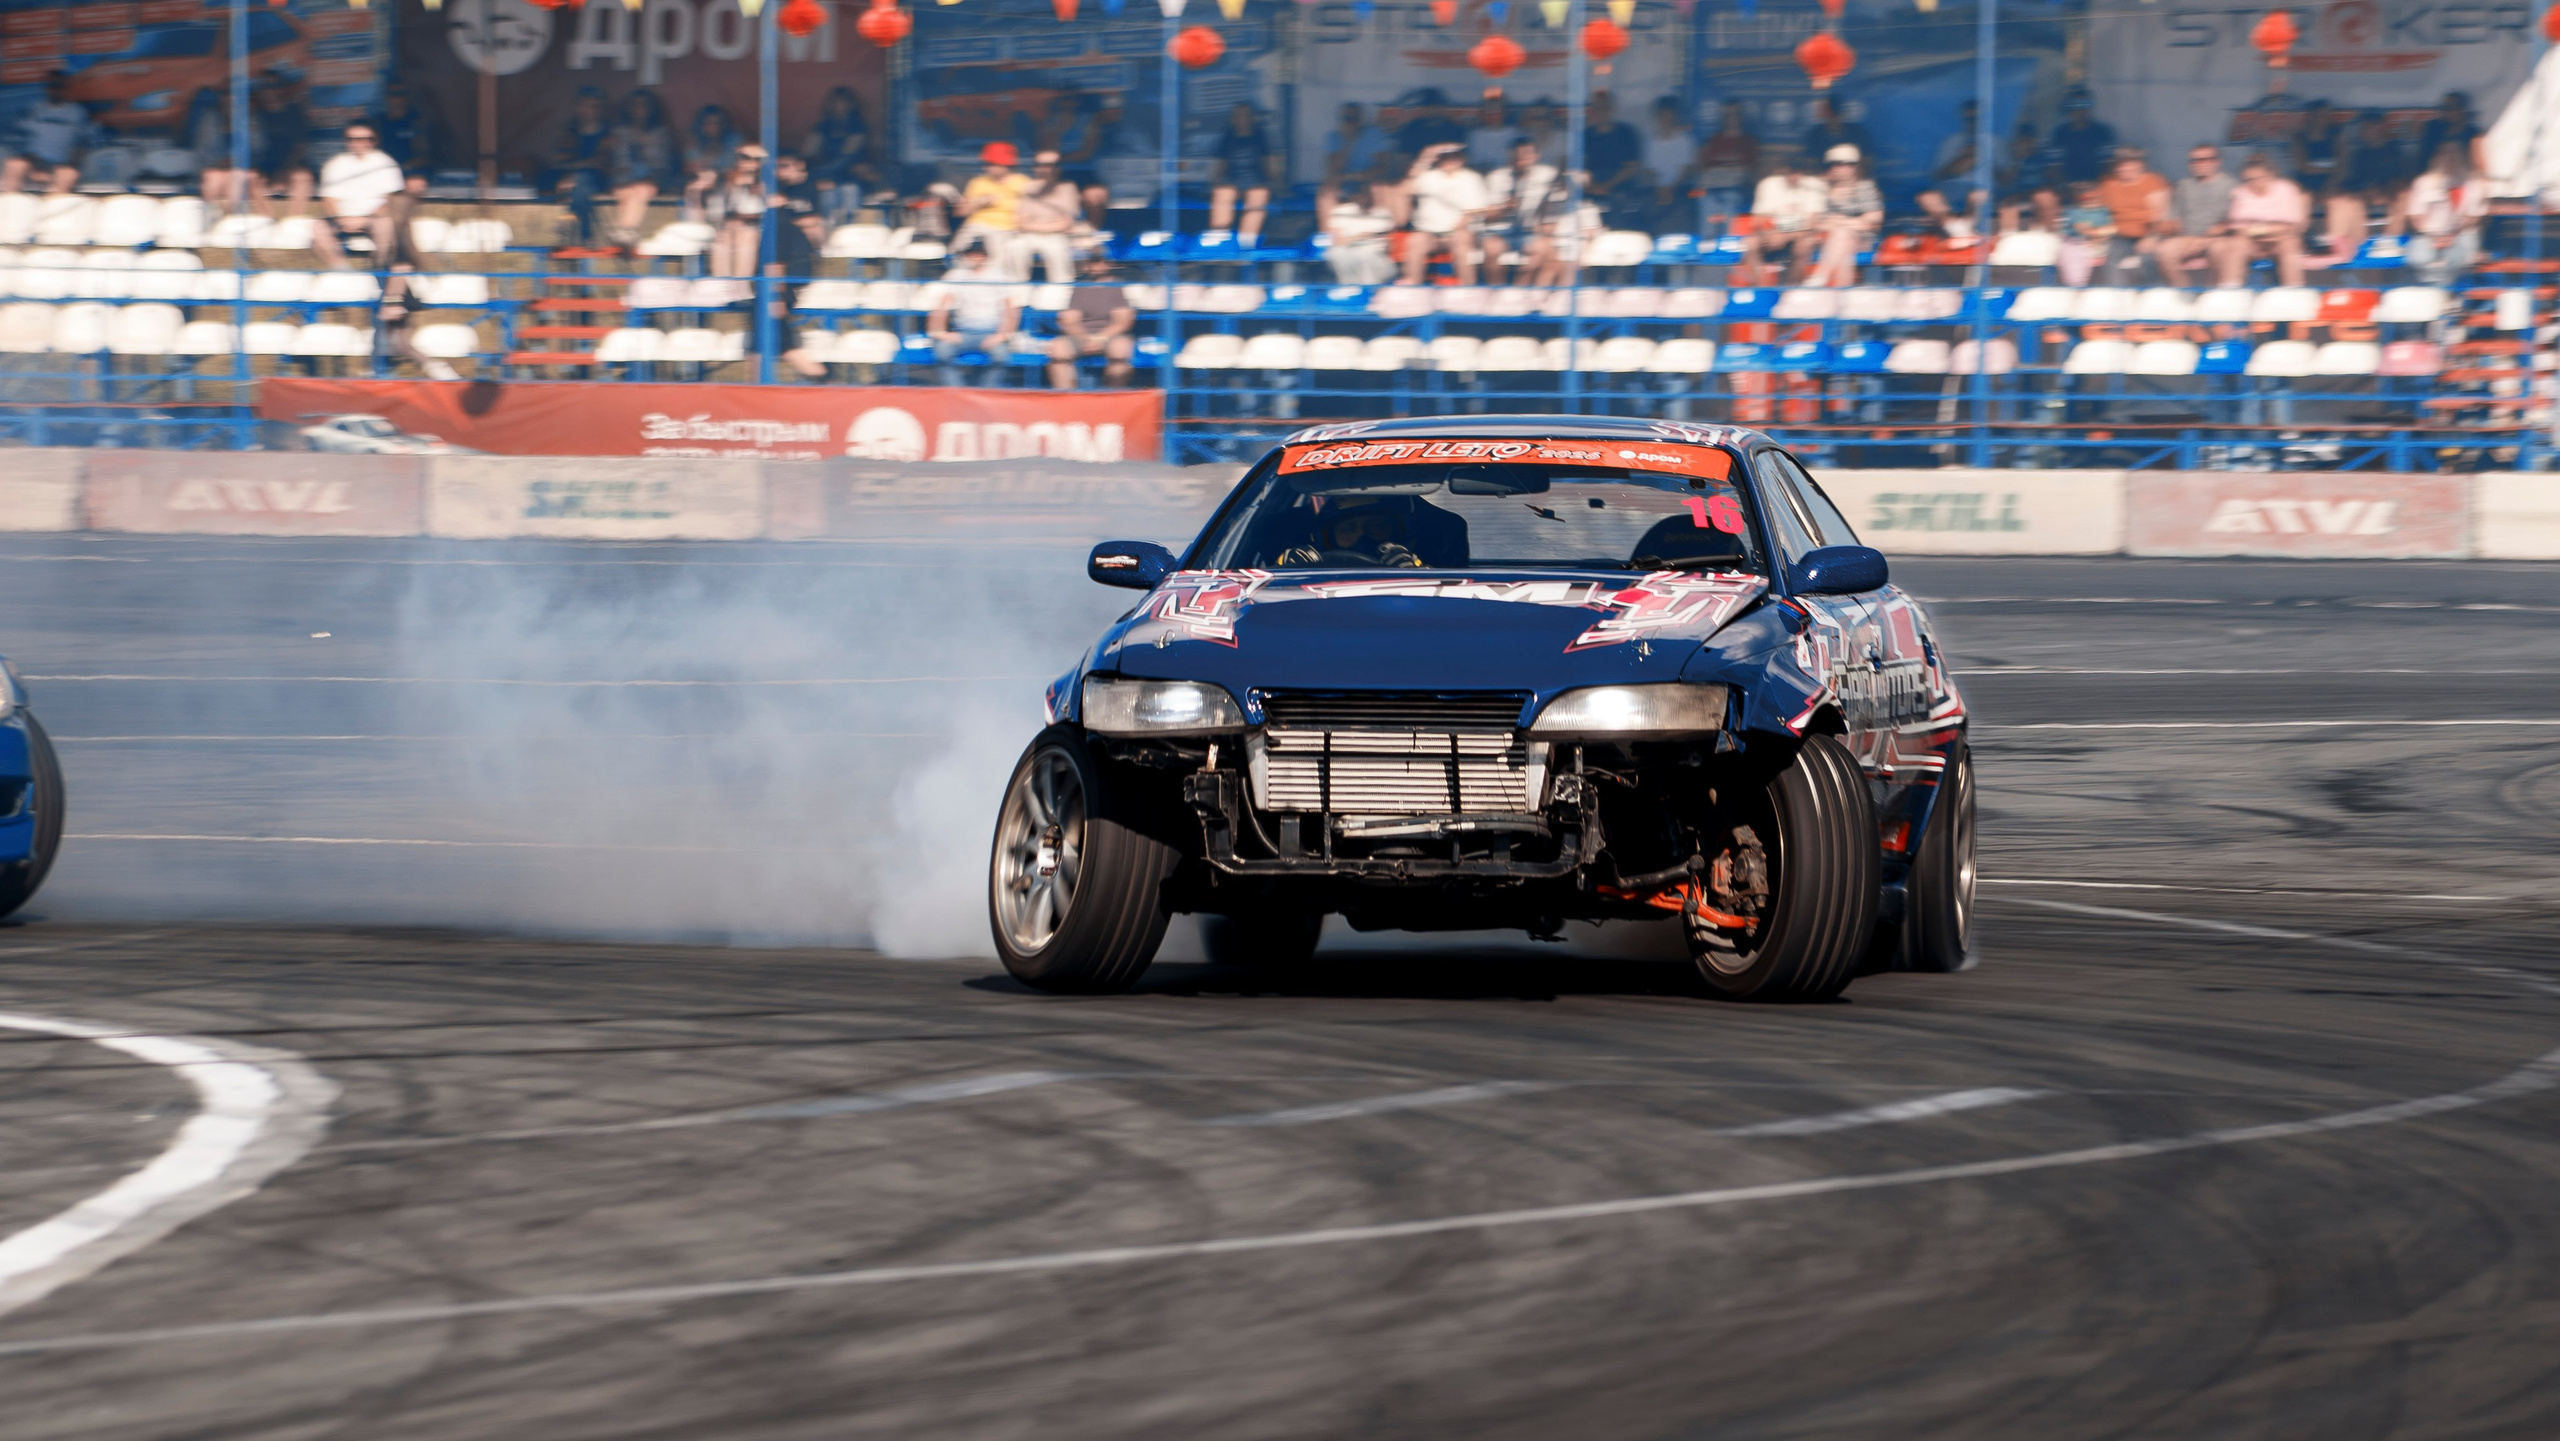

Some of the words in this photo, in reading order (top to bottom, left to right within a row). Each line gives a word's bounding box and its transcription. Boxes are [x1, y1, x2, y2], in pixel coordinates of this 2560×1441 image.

[1295, 443, 1428, 467] DRIFT
[1422, 442, 1532, 460] LETO
[1681, 495, 1744, 534] 16
[1867, 493, 2028, 532] SKILL
